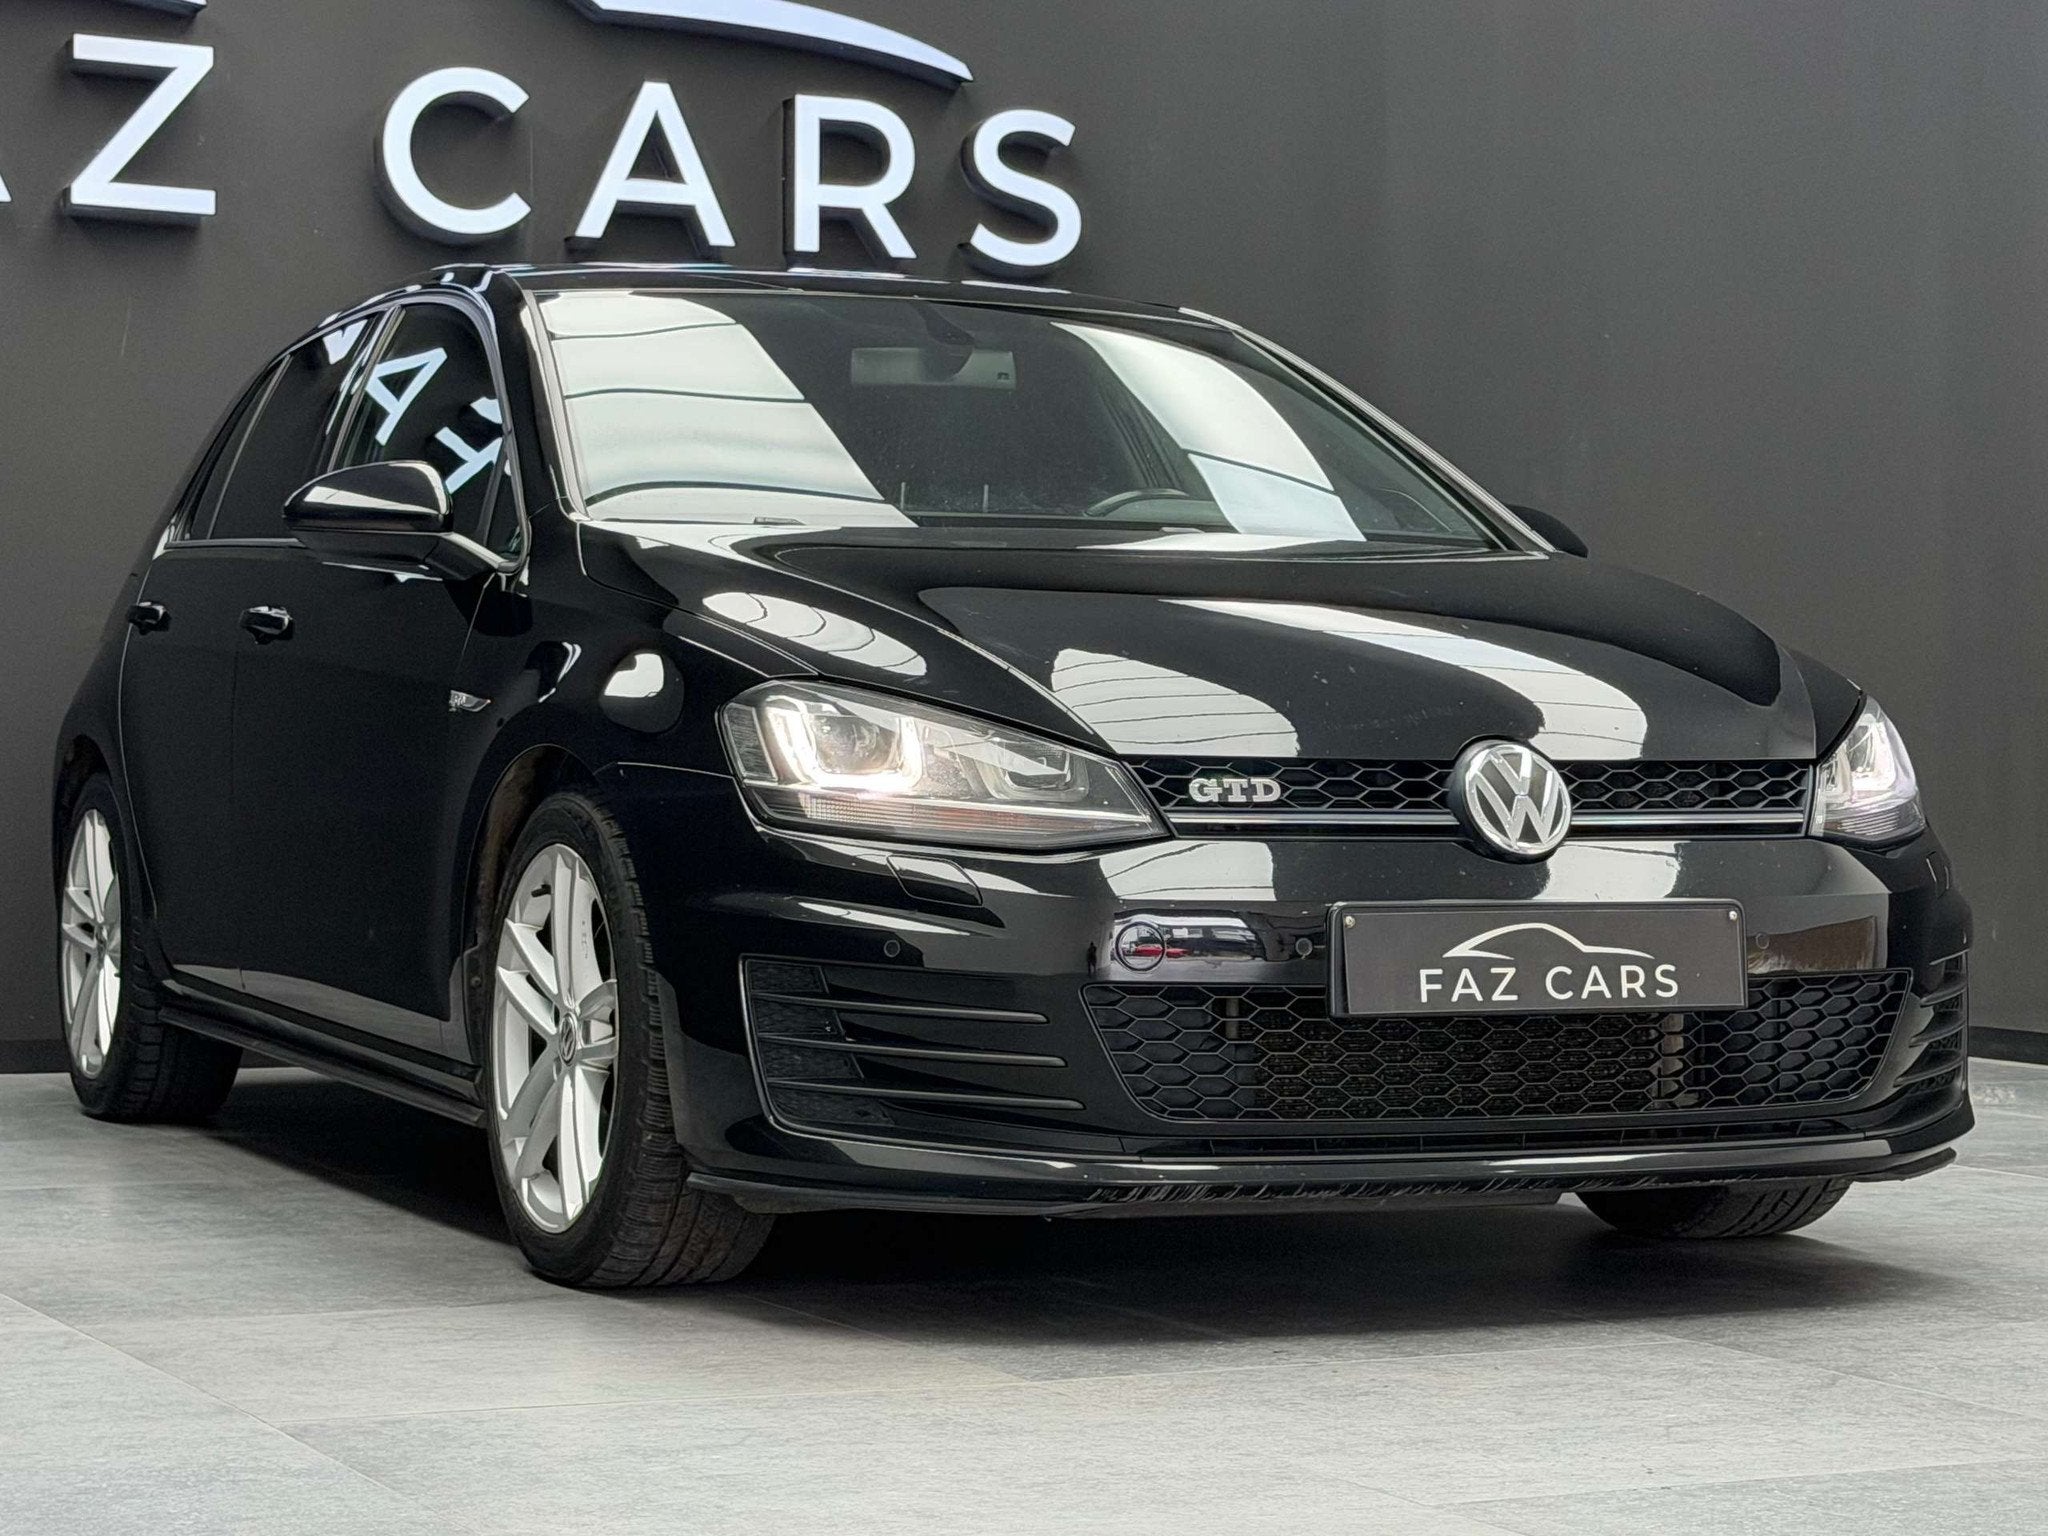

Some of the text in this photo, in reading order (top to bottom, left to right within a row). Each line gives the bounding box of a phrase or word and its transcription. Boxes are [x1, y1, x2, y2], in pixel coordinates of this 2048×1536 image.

[382, 66, 1082, 268] CARS
[1188, 777, 1282, 804] GTD
[1419, 963, 1679, 1003] FAZ CARS
